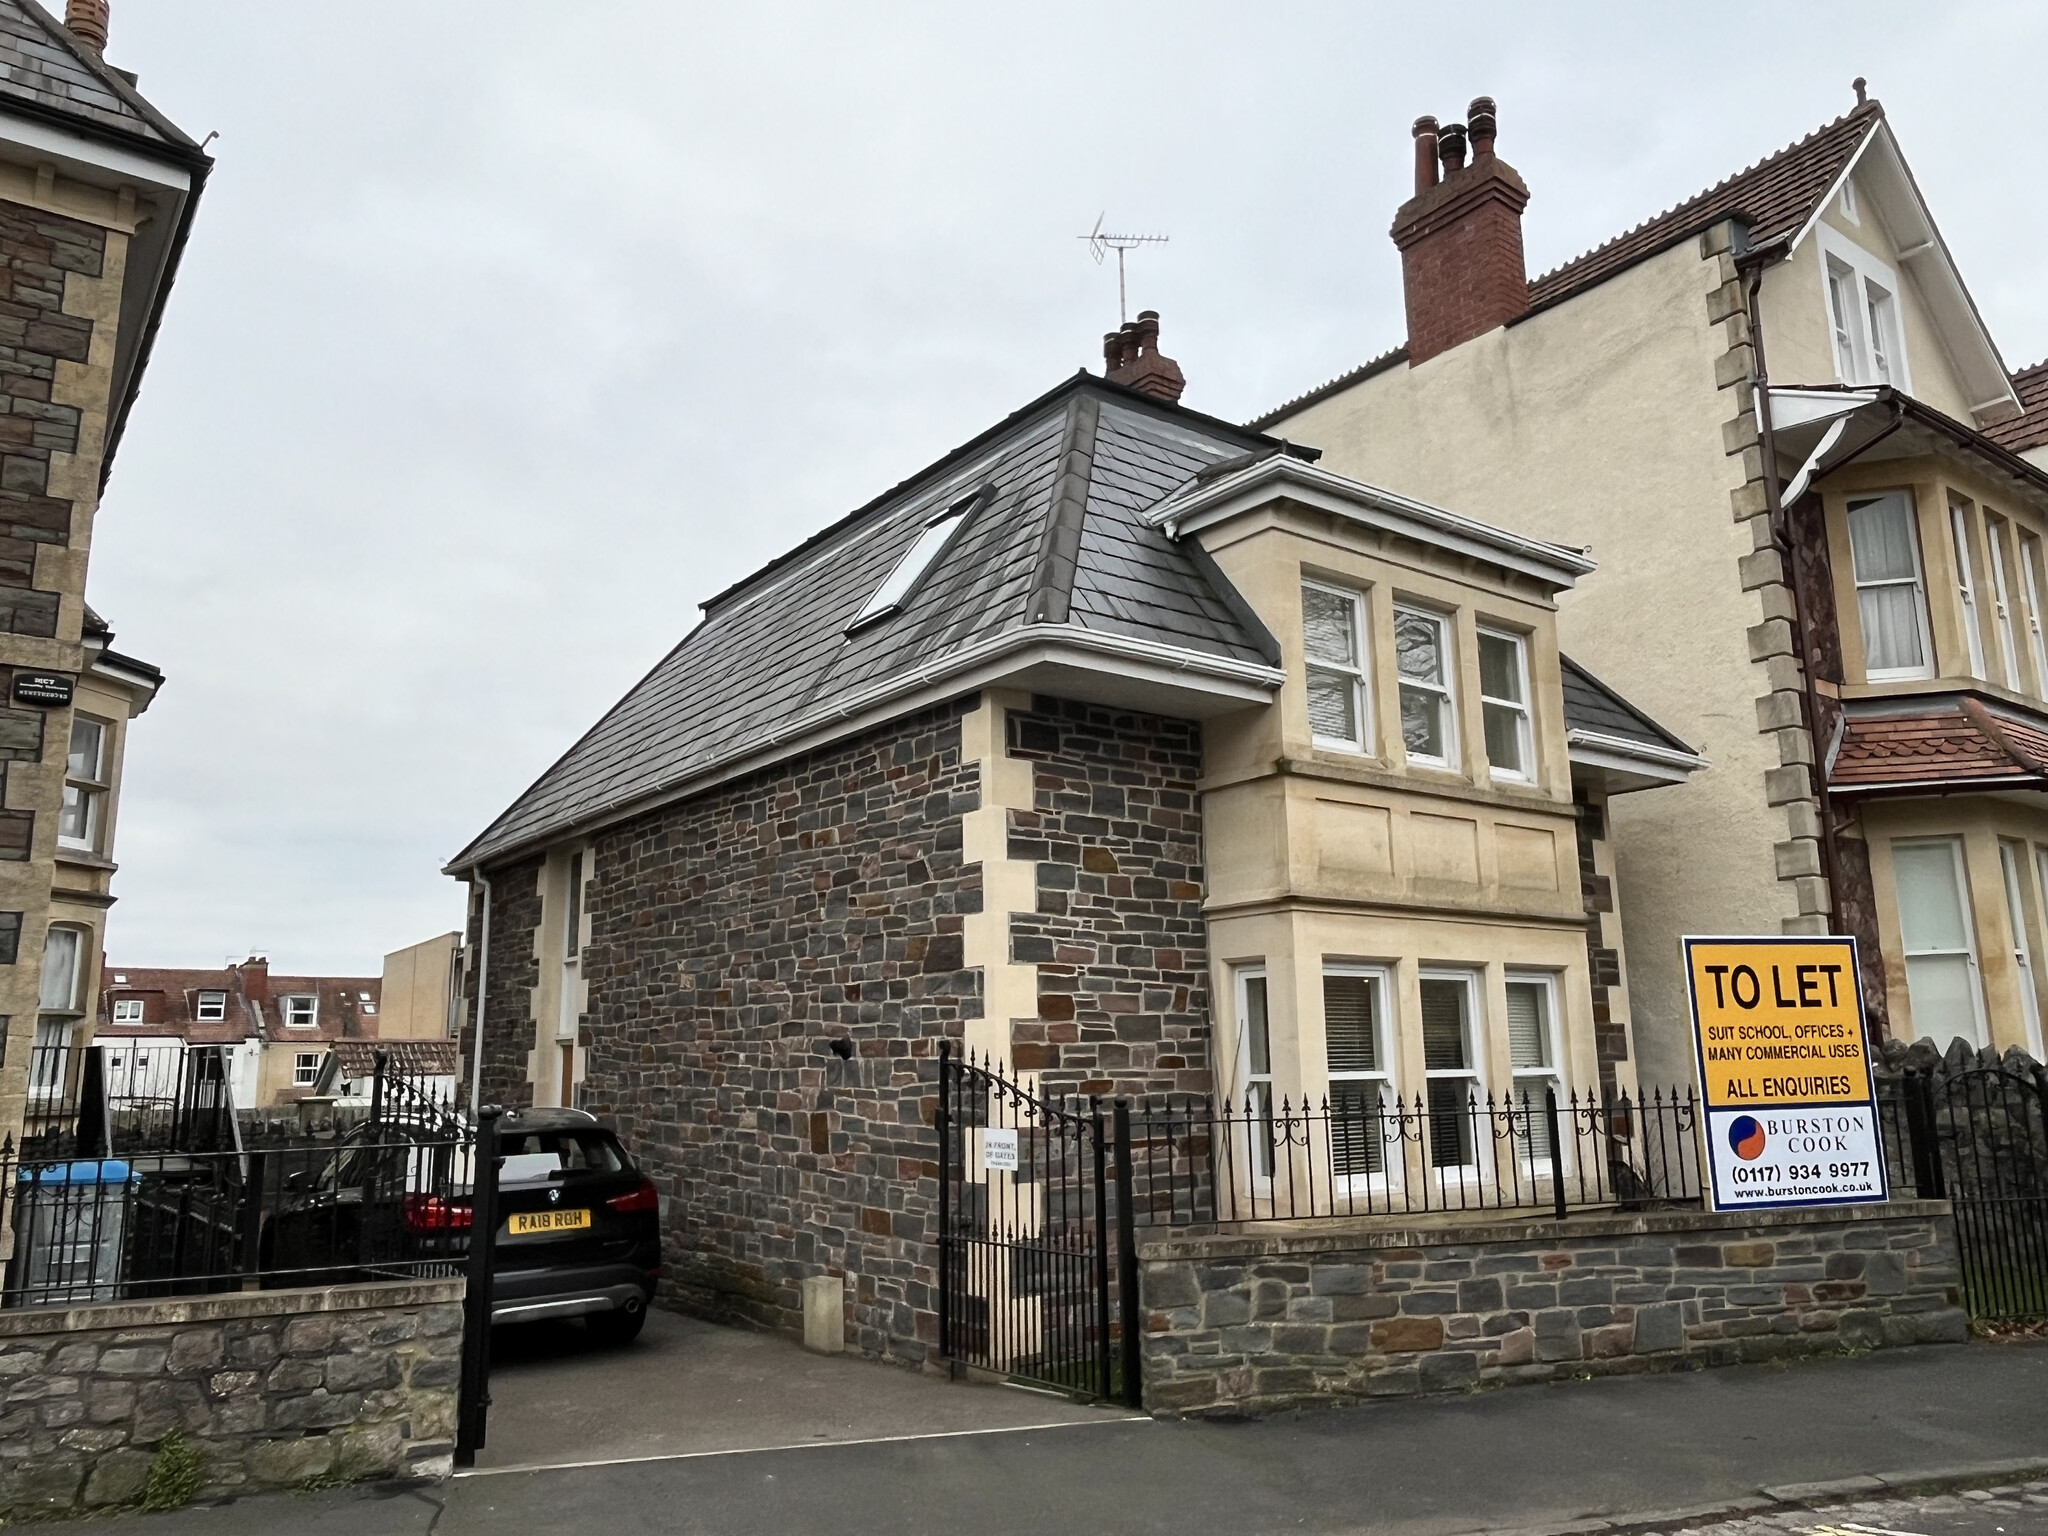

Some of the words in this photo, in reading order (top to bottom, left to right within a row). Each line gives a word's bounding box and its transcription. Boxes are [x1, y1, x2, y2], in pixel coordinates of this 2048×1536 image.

[1705, 965, 1760, 1009] TO
[1772, 965, 1841, 1008] LET
[1709, 1026, 1734, 1040] SUIT
[1739, 1026, 1792, 1041] SCHOOL,
[1795, 1025, 1844, 1038] OFFICES
[1708, 1046, 1742, 1061] MANY
[1746, 1045, 1826, 1059] COMMERCIAL
[1828, 1044, 1859, 1058] USES
[1727, 1078, 1758, 1098] ALL
[1763, 1076, 1851, 1096] ENQUIRIES
[1767, 1116, 1865, 1136] BURSTON
[1788, 1136, 1848, 1153] COOK
[1732, 1164, 1781, 1184] (0117)
[1790, 1163, 1821, 1180] 934
[1829, 1161, 1869, 1177] 9977
[1734, 1182, 1872, 1198] www.burstoncook.co.uk
